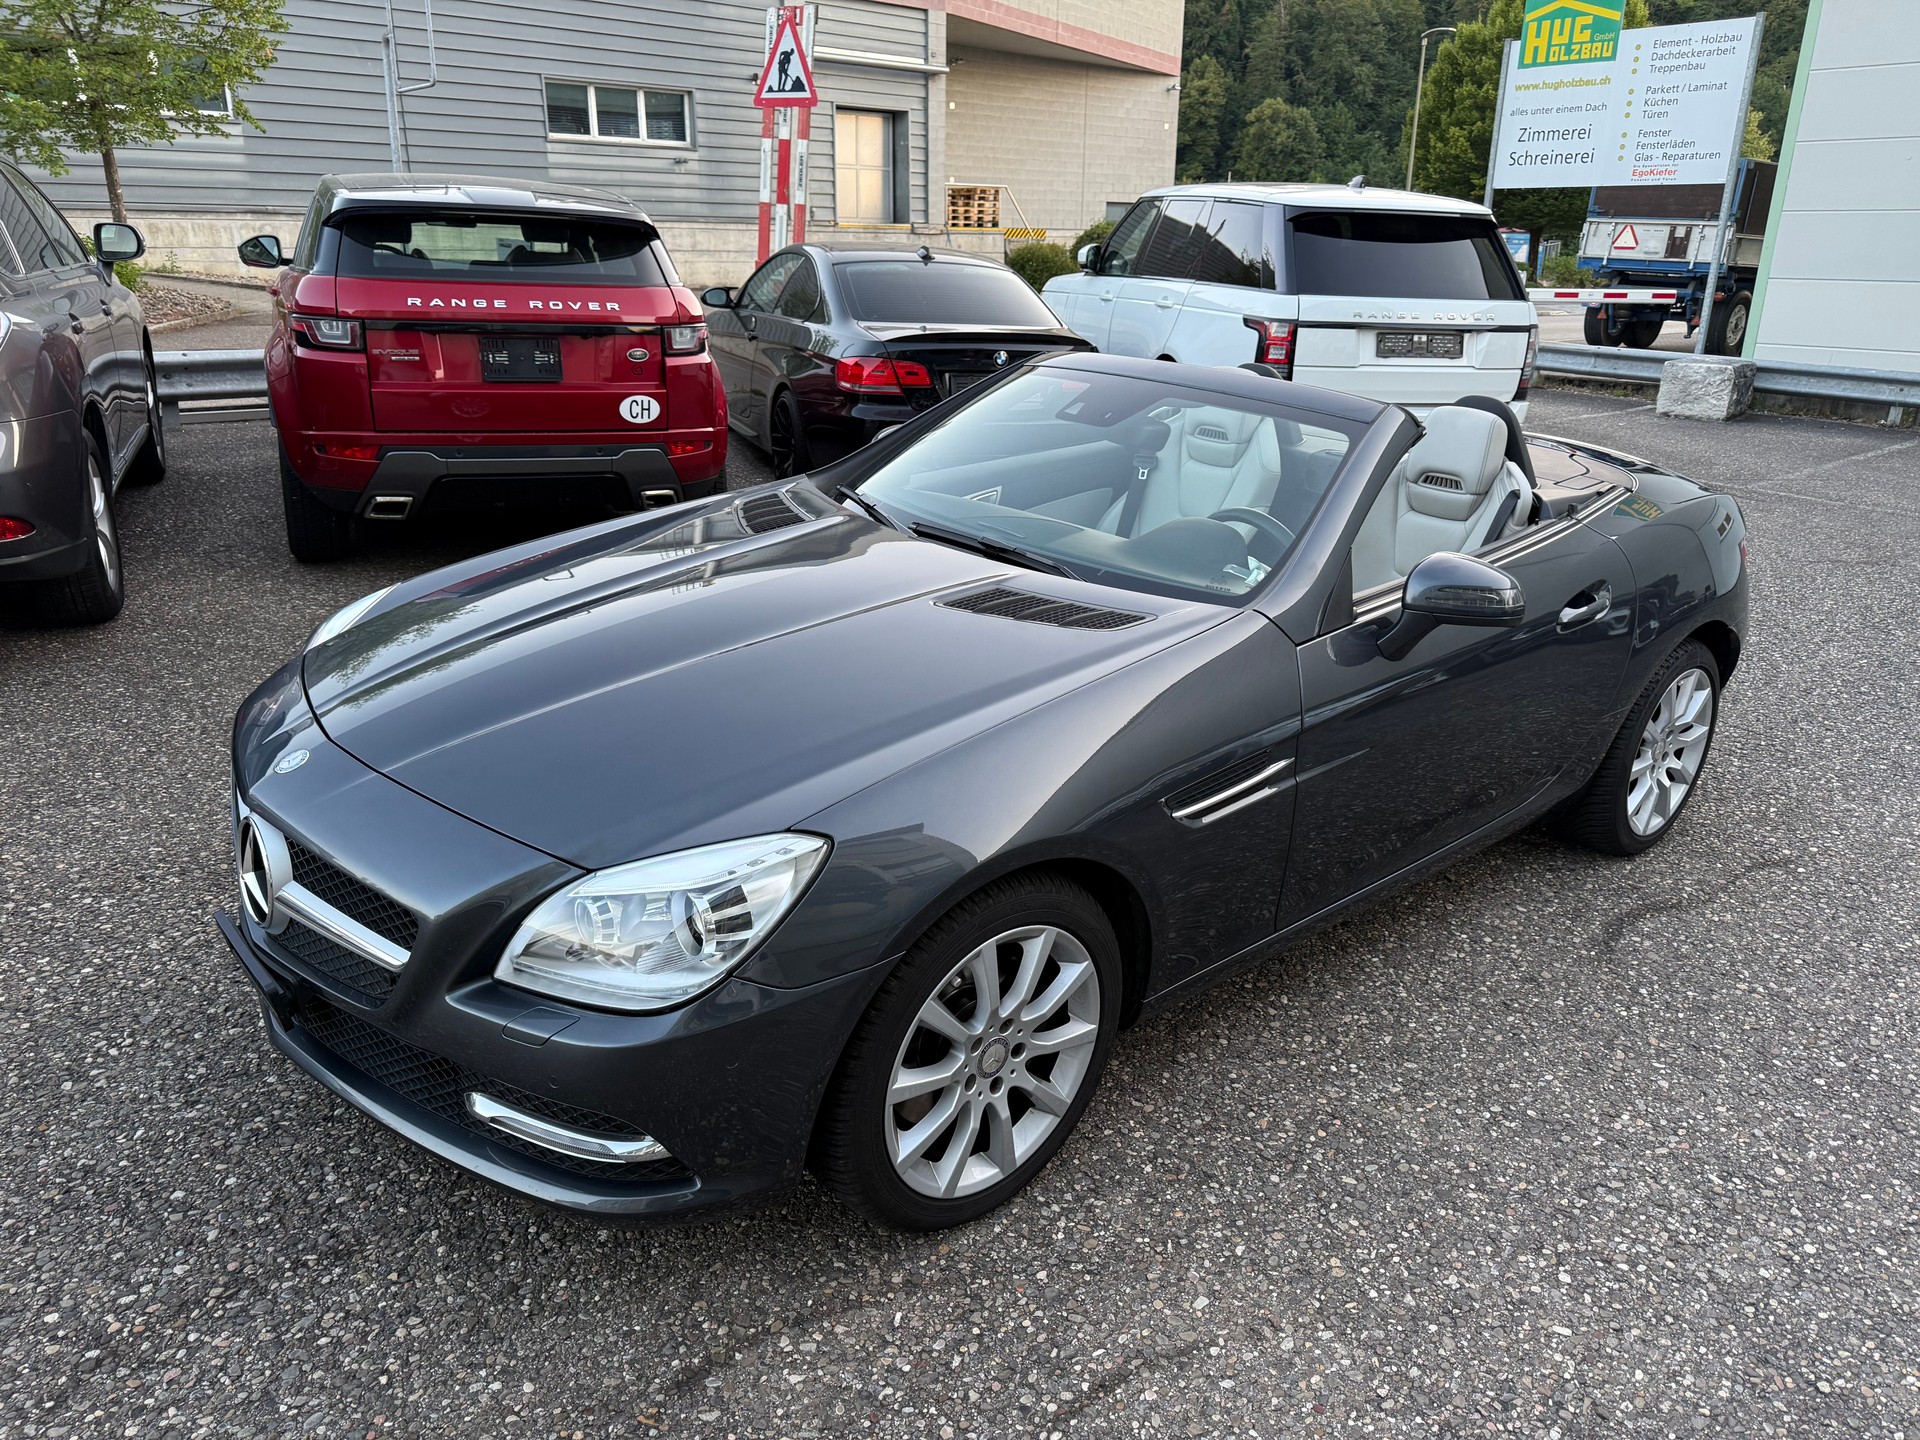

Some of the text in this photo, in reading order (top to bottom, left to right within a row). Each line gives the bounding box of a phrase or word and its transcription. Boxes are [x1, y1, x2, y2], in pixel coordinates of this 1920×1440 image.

[1524, 16, 1593, 64] HUG
[1594, 32, 1615, 41] GmbH
[1653, 37, 1692, 49] Element
[1701, 33, 1742, 45] Holzbau
[1651, 45, 1736, 61] Dachdeckerarbeit
[1649, 61, 1706, 75] Treppenbau
[1514, 75, 1611, 91] www.hugholzbau.ch
[1645, 81, 1728, 95] Parkett / Laminat
[1643, 96, 1678, 107] Küchen
[1510, 102, 1607, 117] alles unter einem Dach
[1642, 109, 1668, 119] Türen
[1517, 123, 1592, 143] Zimmerei
[1637, 129, 1672, 138] Fenster
[1636, 139, 1695, 150] Fensterläden
[1508, 148, 1595, 166] Schreinerei
[1634, 152, 1653, 162] Glas
[1661, 151, 1721, 162] Reparaturen
[1631, 168, 1678, 178] EgoKiefer
[407, 297, 621, 311] RANGE ROVER
[1353, 311, 1496, 321] RANGE ROVER
[629, 399, 651, 419] CH
